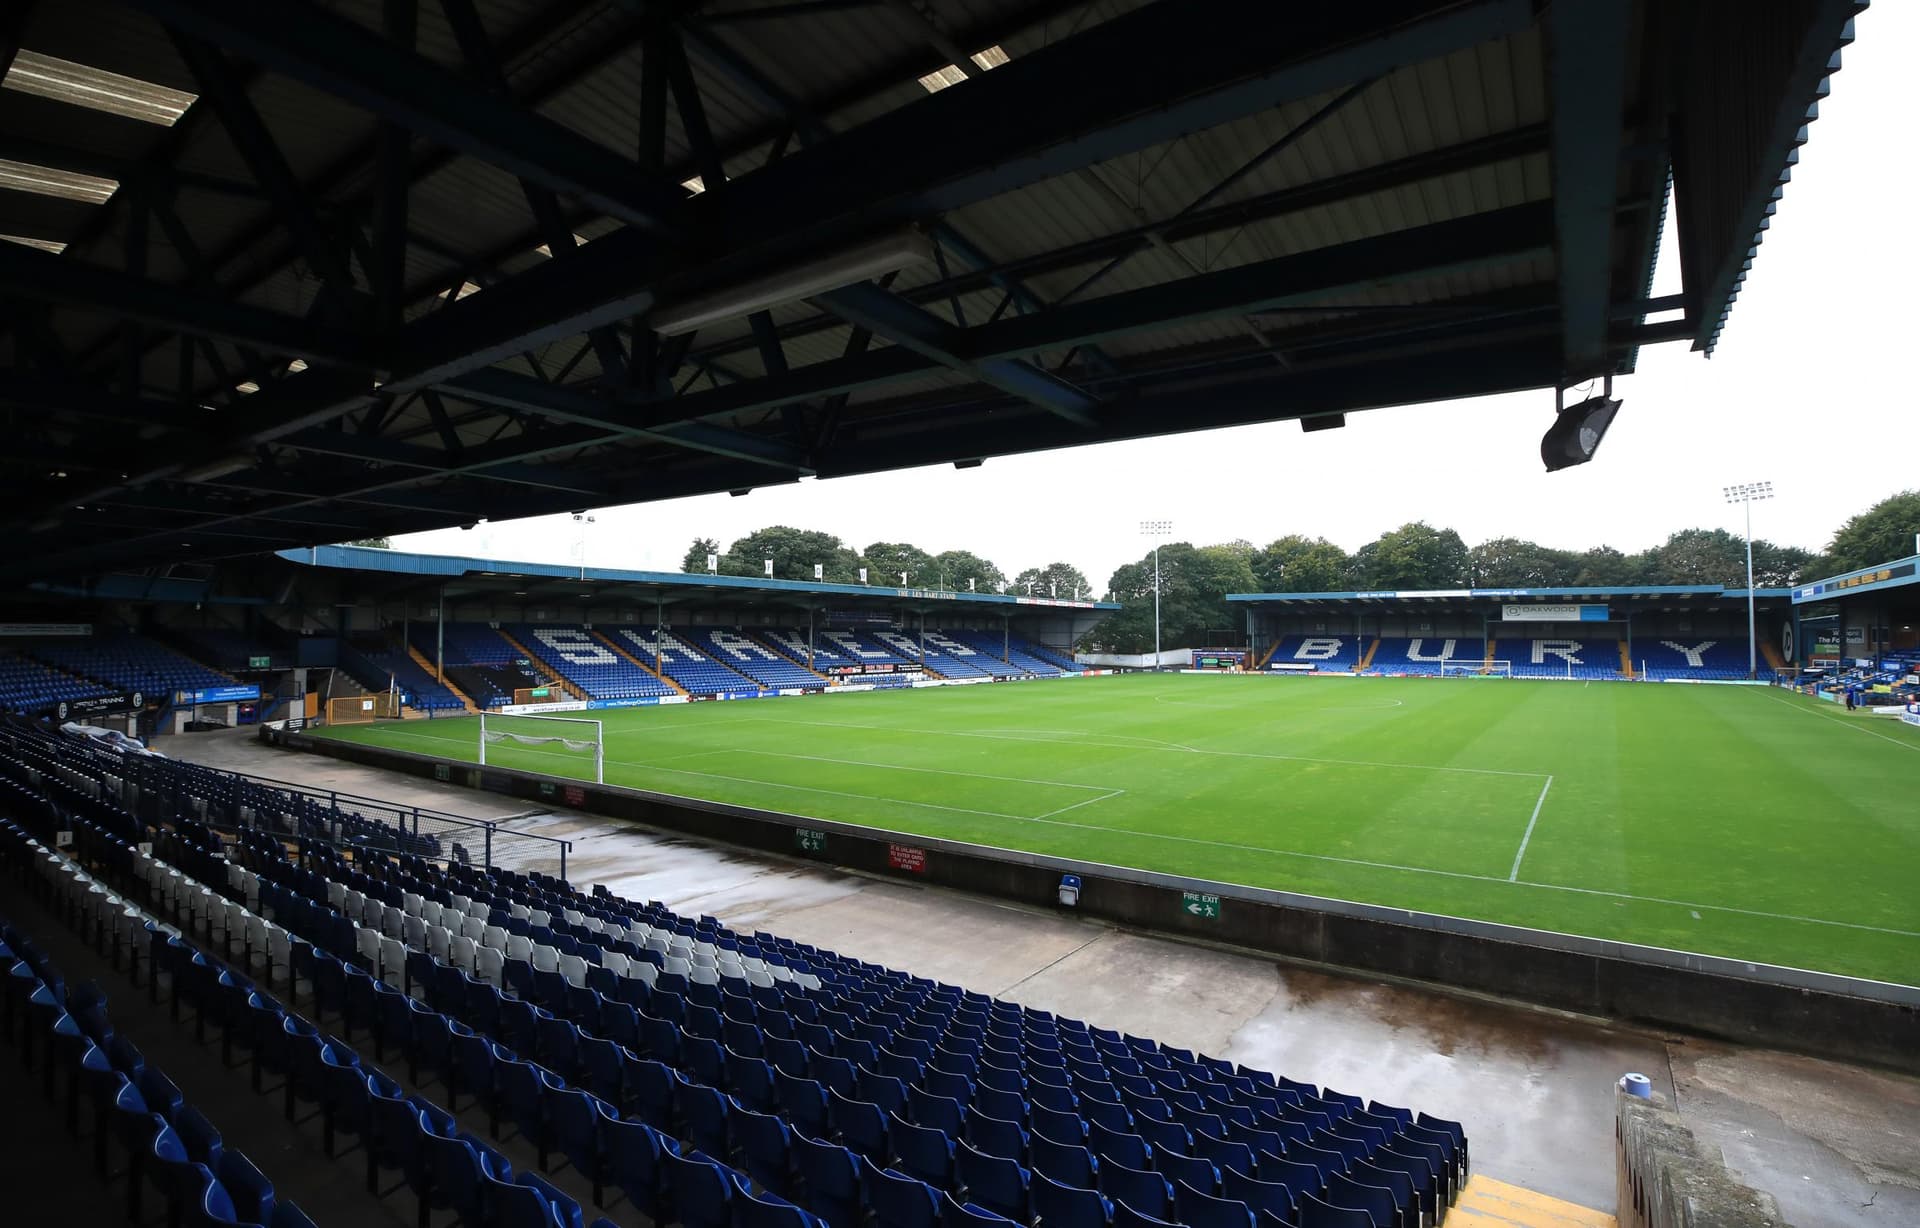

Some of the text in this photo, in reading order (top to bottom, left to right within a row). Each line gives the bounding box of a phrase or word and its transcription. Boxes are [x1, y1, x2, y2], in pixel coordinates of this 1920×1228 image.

[1293, 638, 1717, 667] BURY
[796, 828, 825, 840] FIRE EXIT
[902, 858, 921, 866] PLAYING
[1183, 892, 1219, 904] FIRE EXIT
